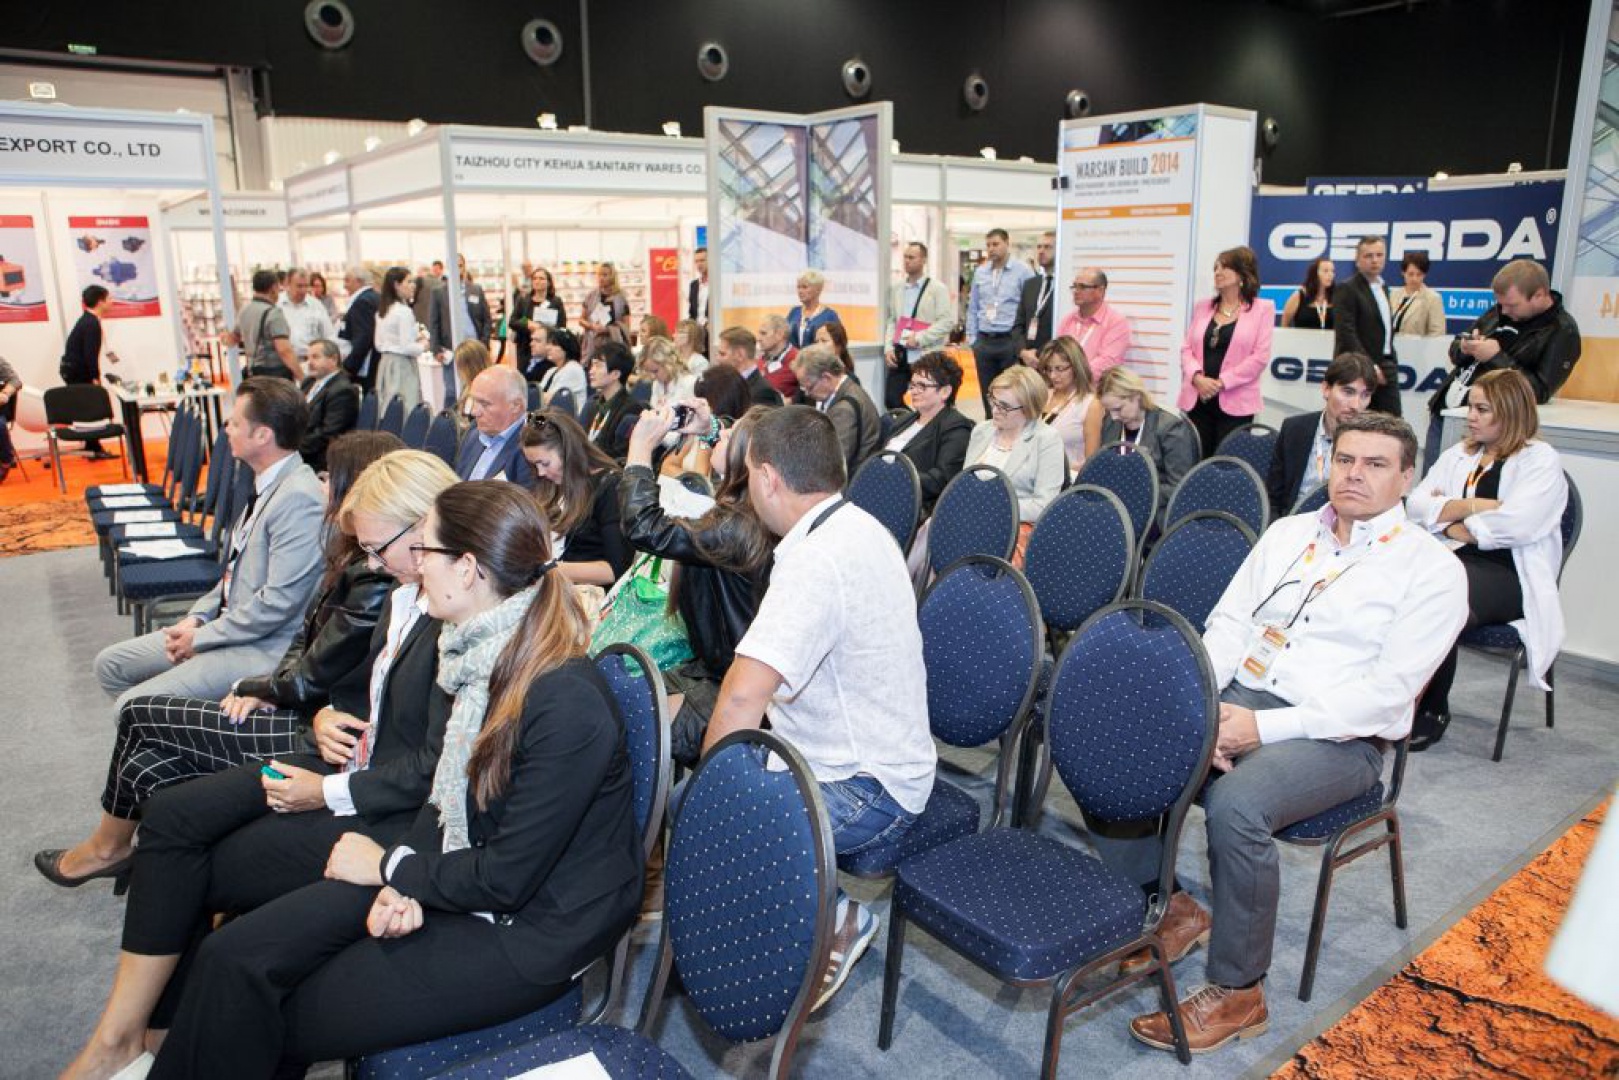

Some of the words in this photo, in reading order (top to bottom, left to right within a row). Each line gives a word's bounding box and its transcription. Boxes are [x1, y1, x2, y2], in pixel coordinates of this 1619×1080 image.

[0, 137, 76, 154] EXPORT
[83, 140, 122, 158] CO.,
[127, 142, 161, 157] LTD
[455, 155, 510, 168] TAIZHOU
[514, 157, 540, 169] CITY
[544, 158, 584, 170] KEHUA
[587, 160, 641, 172] SANITARY
[645, 162, 683, 174] WARES
[1076, 160, 1117, 178] WARSAW
[1119, 157, 1149, 176] BUILD
[1151, 152, 1179, 174] 2014
[1449, 295, 1497, 310] bram
